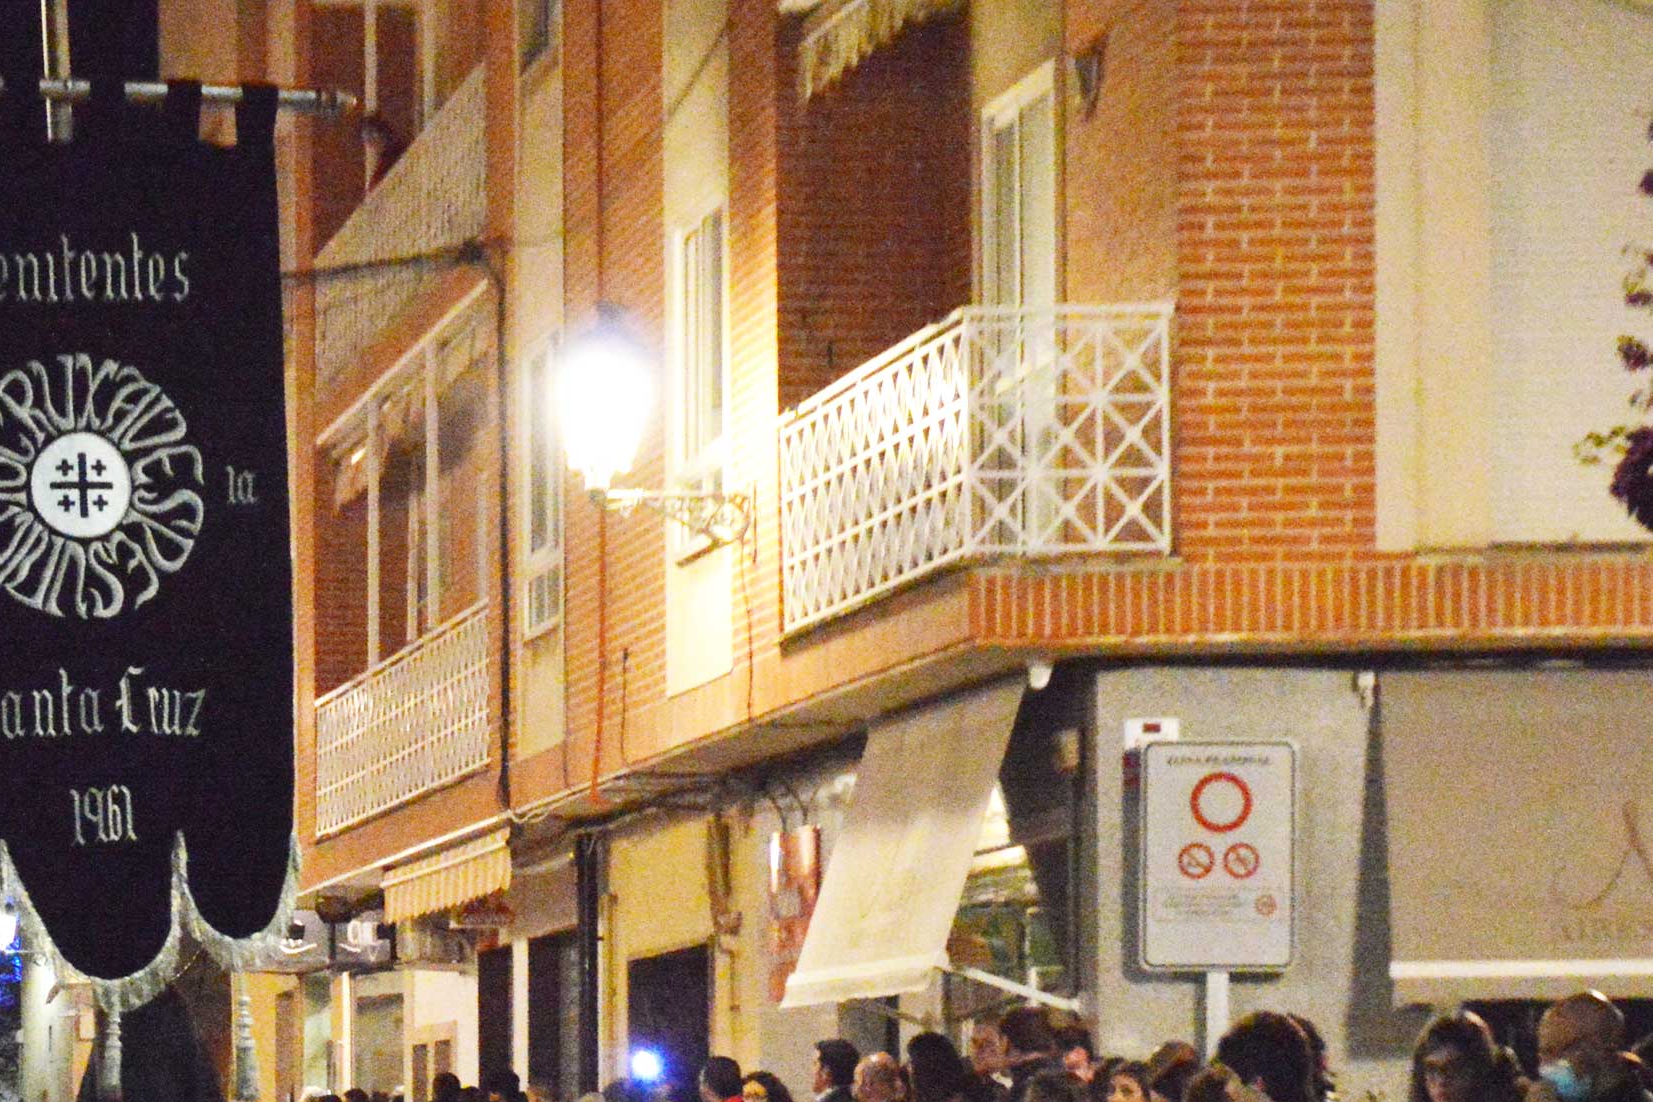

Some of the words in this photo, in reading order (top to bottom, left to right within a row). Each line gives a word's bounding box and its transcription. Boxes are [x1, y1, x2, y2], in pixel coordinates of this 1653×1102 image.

[226, 465, 258, 504] la
[113, 665, 206, 737] Cruz
[69, 783, 138, 846] 1961
